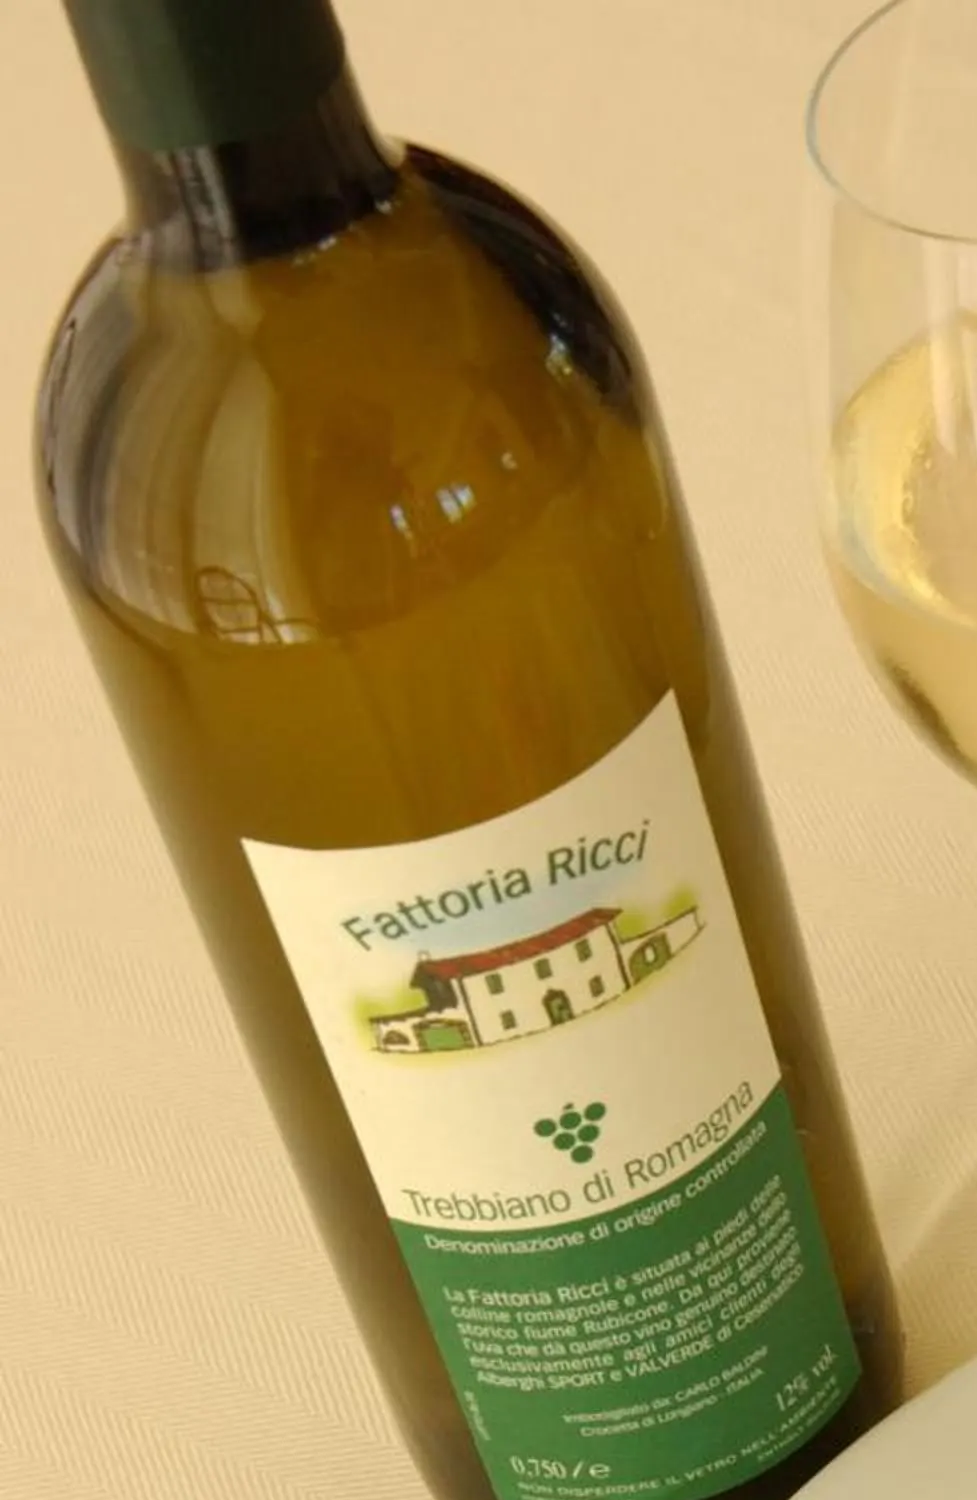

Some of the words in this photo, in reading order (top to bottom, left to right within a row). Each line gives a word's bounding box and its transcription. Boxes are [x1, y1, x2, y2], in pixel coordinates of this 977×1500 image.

[340, 867, 532, 951] Fattoria
[546, 821, 650, 887] Ricci
[401, 1188, 571, 1222] Trebbiano
[583, 1169, 615, 1204] di
[624, 1080, 754, 1189] Romagna
[424, 1231, 585, 1255] Denominazione
[589, 1222, 609, 1241] di
[614, 1192, 682, 1233] origine
[685, 1120, 767, 1198] controllata
[451, 1305, 510, 1323] colline
[516, 1298, 619, 1323] romagnole
[624, 1293, 636, 1307] e
[641, 1273, 686, 1300] nelle
[688, 1223, 757, 1278] vicinanze
[456, 1322, 518, 1340] storico
[523, 1324, 578, 1340] fiume
[583, 1301, 674, 1335] Rubicone.
[679, 1284, 703, 1304] Da
[707, 1263, 733, 1289] qui
[467, 1288, 552, 1307] Fattoria
[557, 1277, 609, 1301] Ricci
[631, 1251, 691, 1285] situata
[695, 1236, 710, 1256] ai
[713, 1207, 749, 1246] piedi
[469, 1353, 614, 1374] esclusivamente
[624, 1341, 657, 1361] agli
[665, 1313, 714, 1348] amici
[720, 1278, 767, 1320] clienti
[477, 1369, 545, 1391] Alberghi
[547, 1371, 605, 1389] SPORT
[609, 1368, 623, 1382] e
[625, 1334, 714, 1377] VALVERDE
[716, 1325, 732, 1342] di
[507, 1341, 540, 1357] che
[568, 1332, 631, 1354] questo
[633, 1318, 672, 1340] vino
[674, 1282, 739, 1328] genuino
[684, 1455, 737, 1482] VETRO
